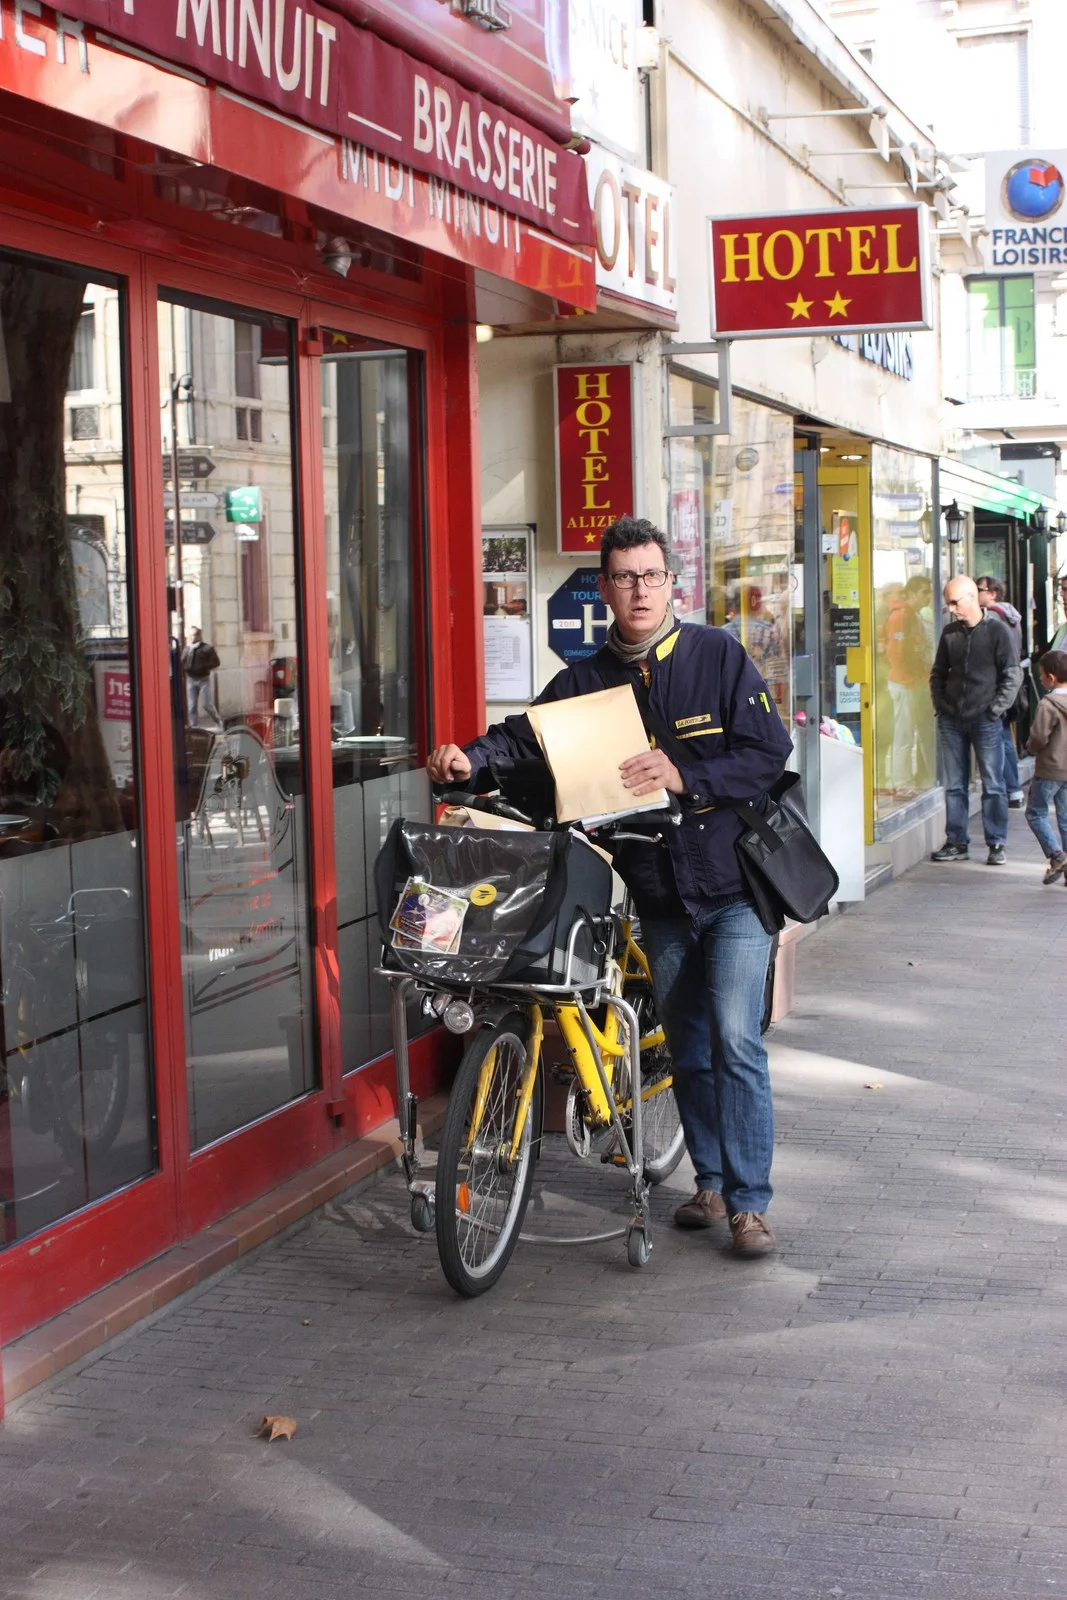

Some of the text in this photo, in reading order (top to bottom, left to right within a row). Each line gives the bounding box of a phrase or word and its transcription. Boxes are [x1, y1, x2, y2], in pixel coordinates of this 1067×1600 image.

[175, 0, 337, 107] MINUIT
[413, 73, 558, 216] BRASSERIE
[720, 224, 917, 282] HOTEL
[574, 373, 612, 509] HOTEL
